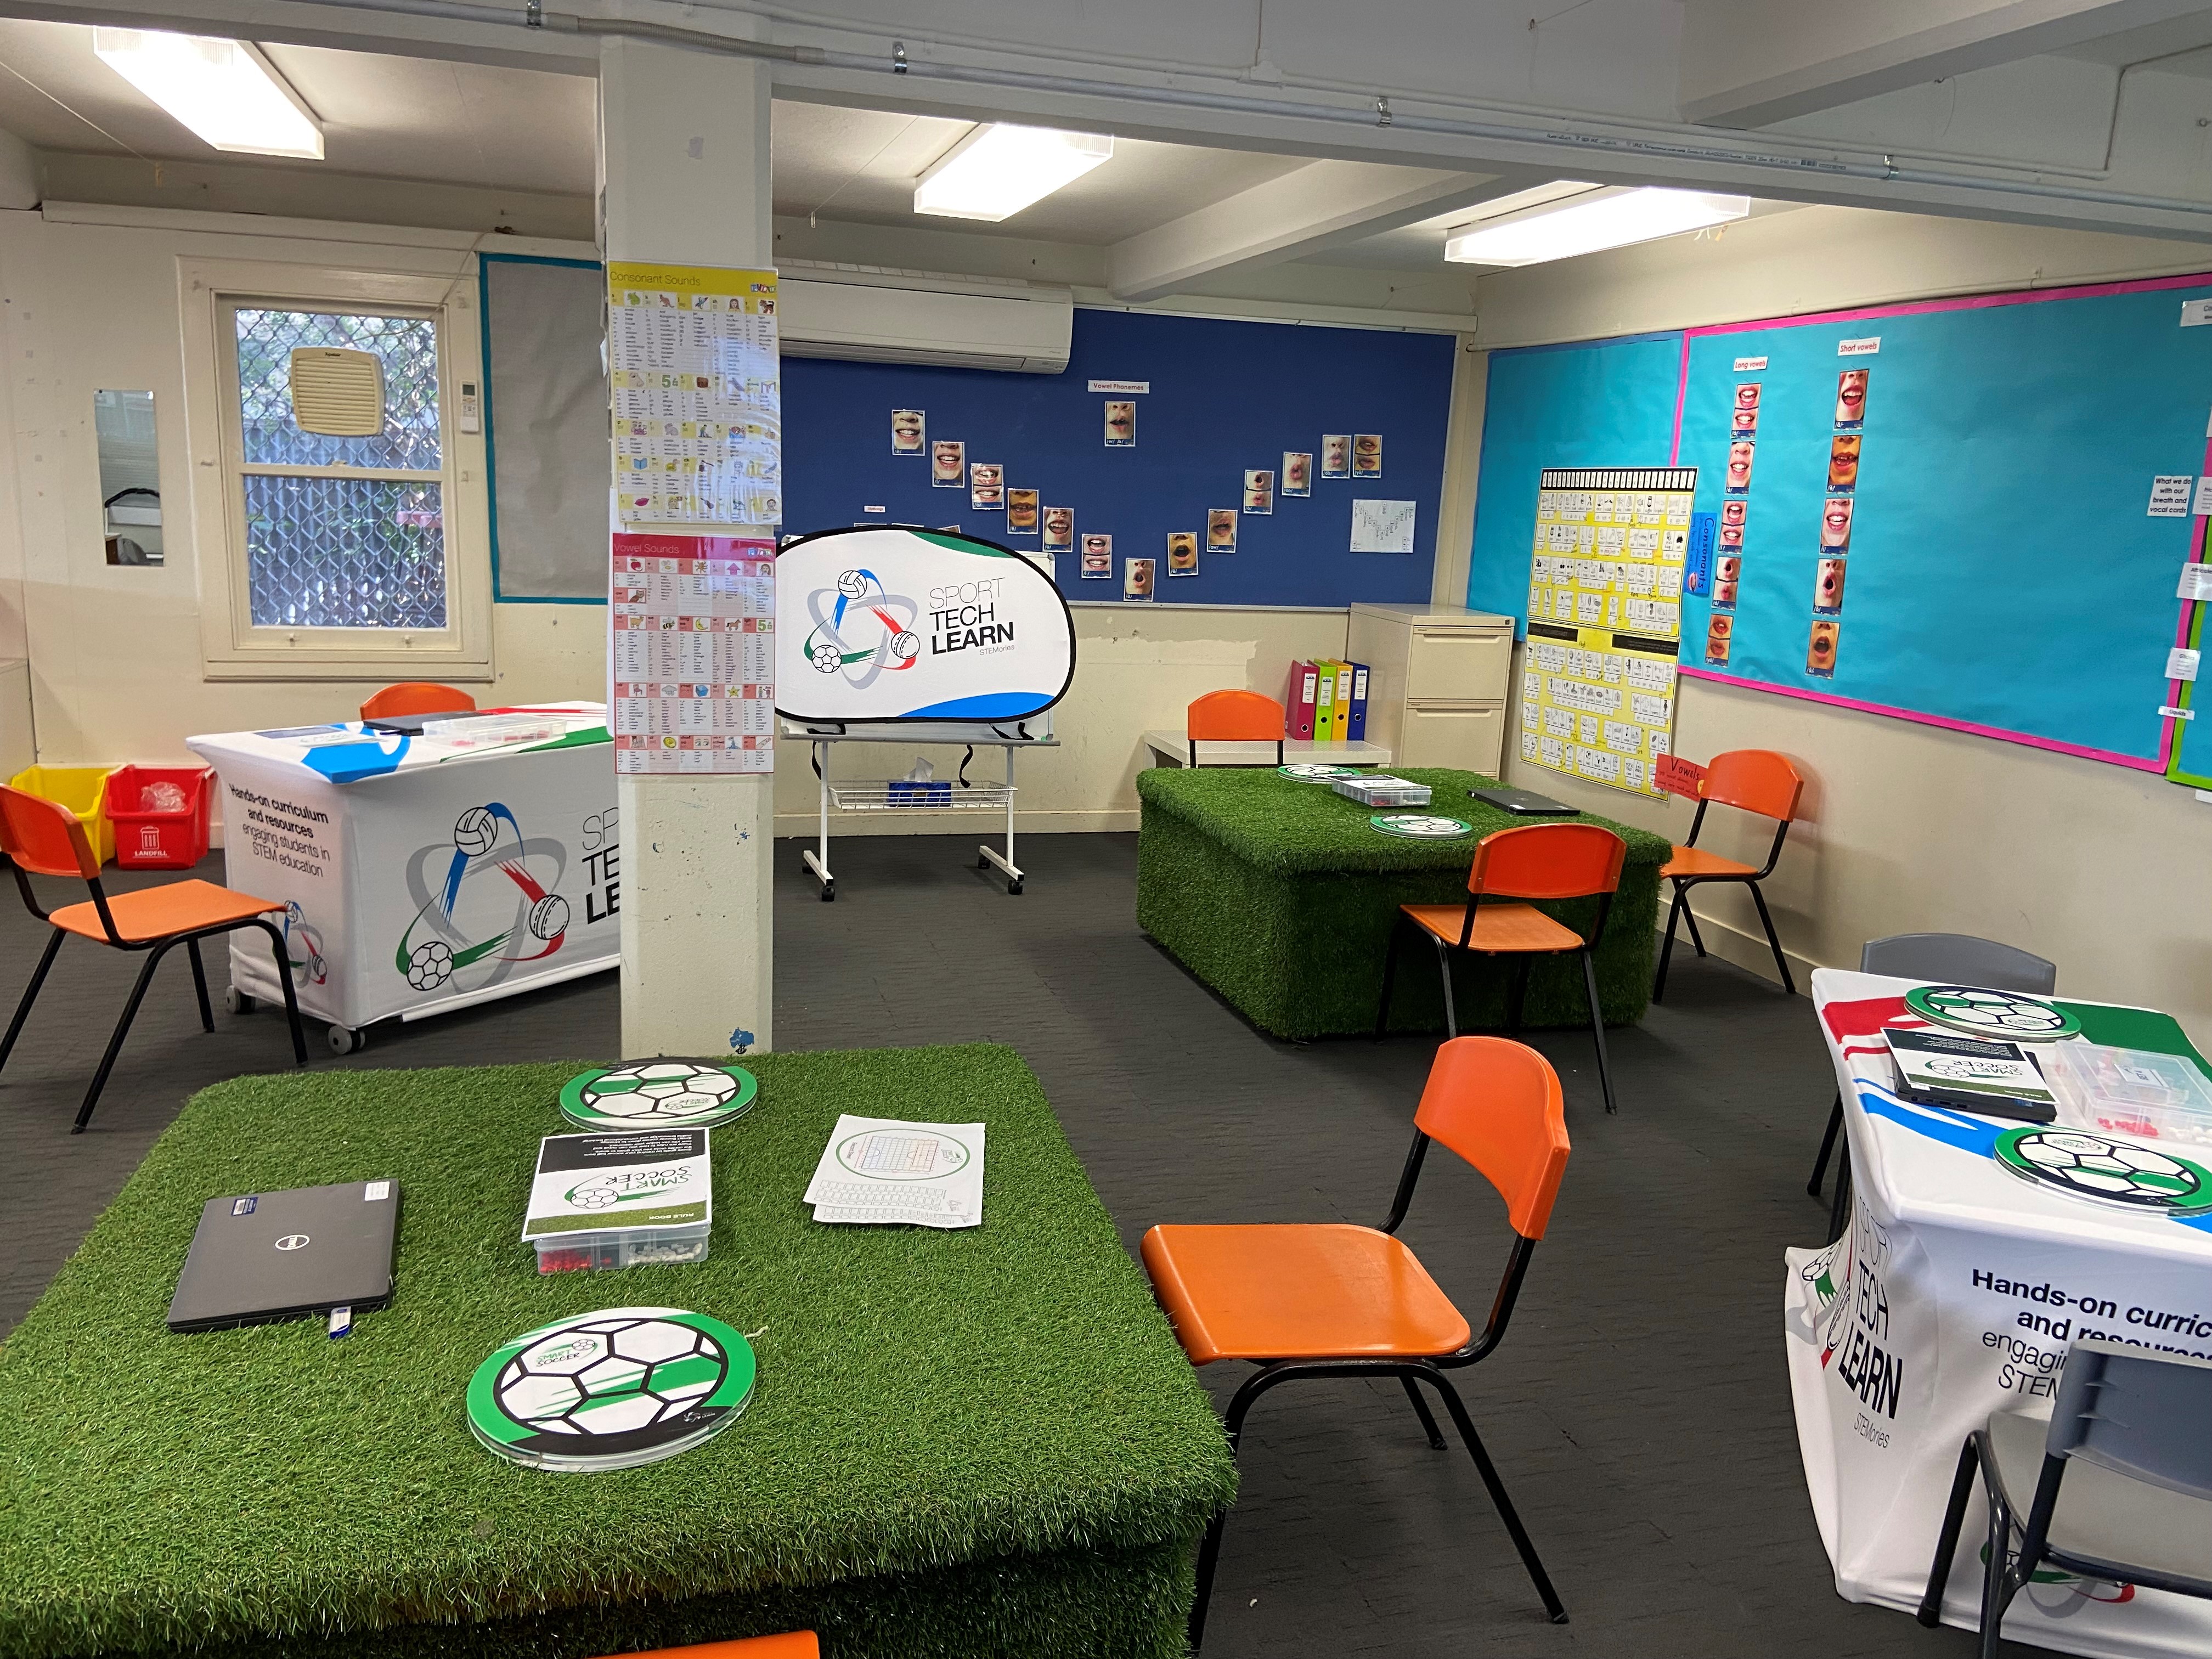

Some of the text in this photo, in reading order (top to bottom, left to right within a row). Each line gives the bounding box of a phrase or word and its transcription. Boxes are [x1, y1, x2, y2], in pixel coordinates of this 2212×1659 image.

[610, 271, 701, 286] Consonant Sounds
[1840, 342, 1877, 352] Short vowels
[614, 543, 680, 554] Vowel Sounds
[1698, 517, 1714, 589] Consonants
[929, 577, 1006, 609] SPORT
[929, 602, 994, 631] TECH
[932, 622, 1014, 654] LEARN
[979, 645, 1015, 656] STEMories
[1671, 758, 1700, 780] Vowels
[229, 783, 329, 824] Hands-on curriculum
[247, 808, 314, 838] and resources
[242, 823, 330, 862] engaging students in
[252, 841, 323, 877] STEM education
[582, 844, 619, 886] TE
[1952, 1060, 2019, 1071] SOCCER
[1971, 1066, 2023, 1075] SMART
[606, 1166, 691, 1184] SOCCER
[620, 1174, 692, 1192] SMART
[1856, 1258, 1888, 1341] TECH
[1972, 1268, 2118, 1319] Hands-on
[2017, 1311, 2072, 1341] and
[536, 1349, 571, 1362] SMART
[536, 1352, 580, 1367] SOCCER
[1982, 1331, 2067, 1374] engagi
[1838, 1321, 1903, 1419] LEARN
[1854, 1412, 1889, 1448] STEMories
